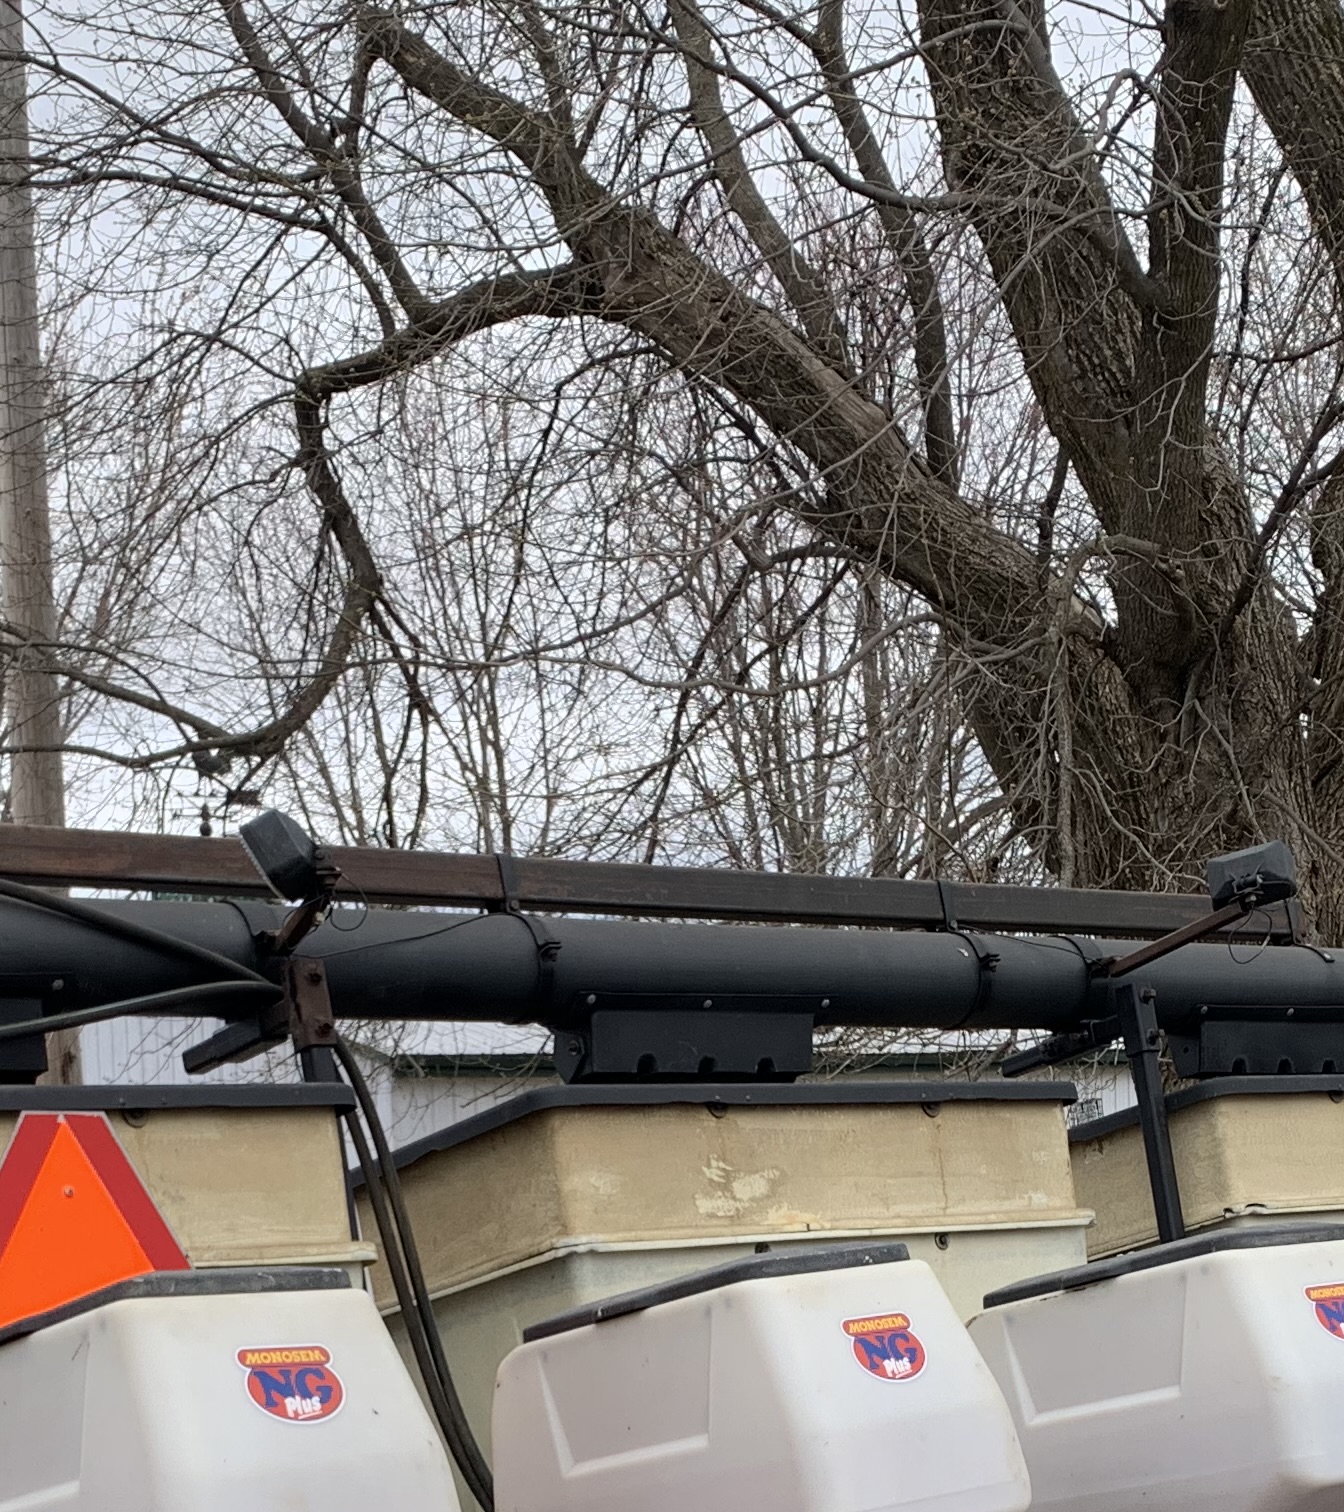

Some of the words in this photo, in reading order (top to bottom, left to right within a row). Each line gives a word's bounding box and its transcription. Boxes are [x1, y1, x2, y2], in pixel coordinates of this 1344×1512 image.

[848, 1316, 908, 1334] MONOSEM
[244, 1349, 327, 1366] MONOSEM
[856, 1333, 918, 1370] NG
[882, 1357, 912, 1378] Plus
[252, 1367, 334, 1408] NG
[284, 1395, 323, 1419] Plus
